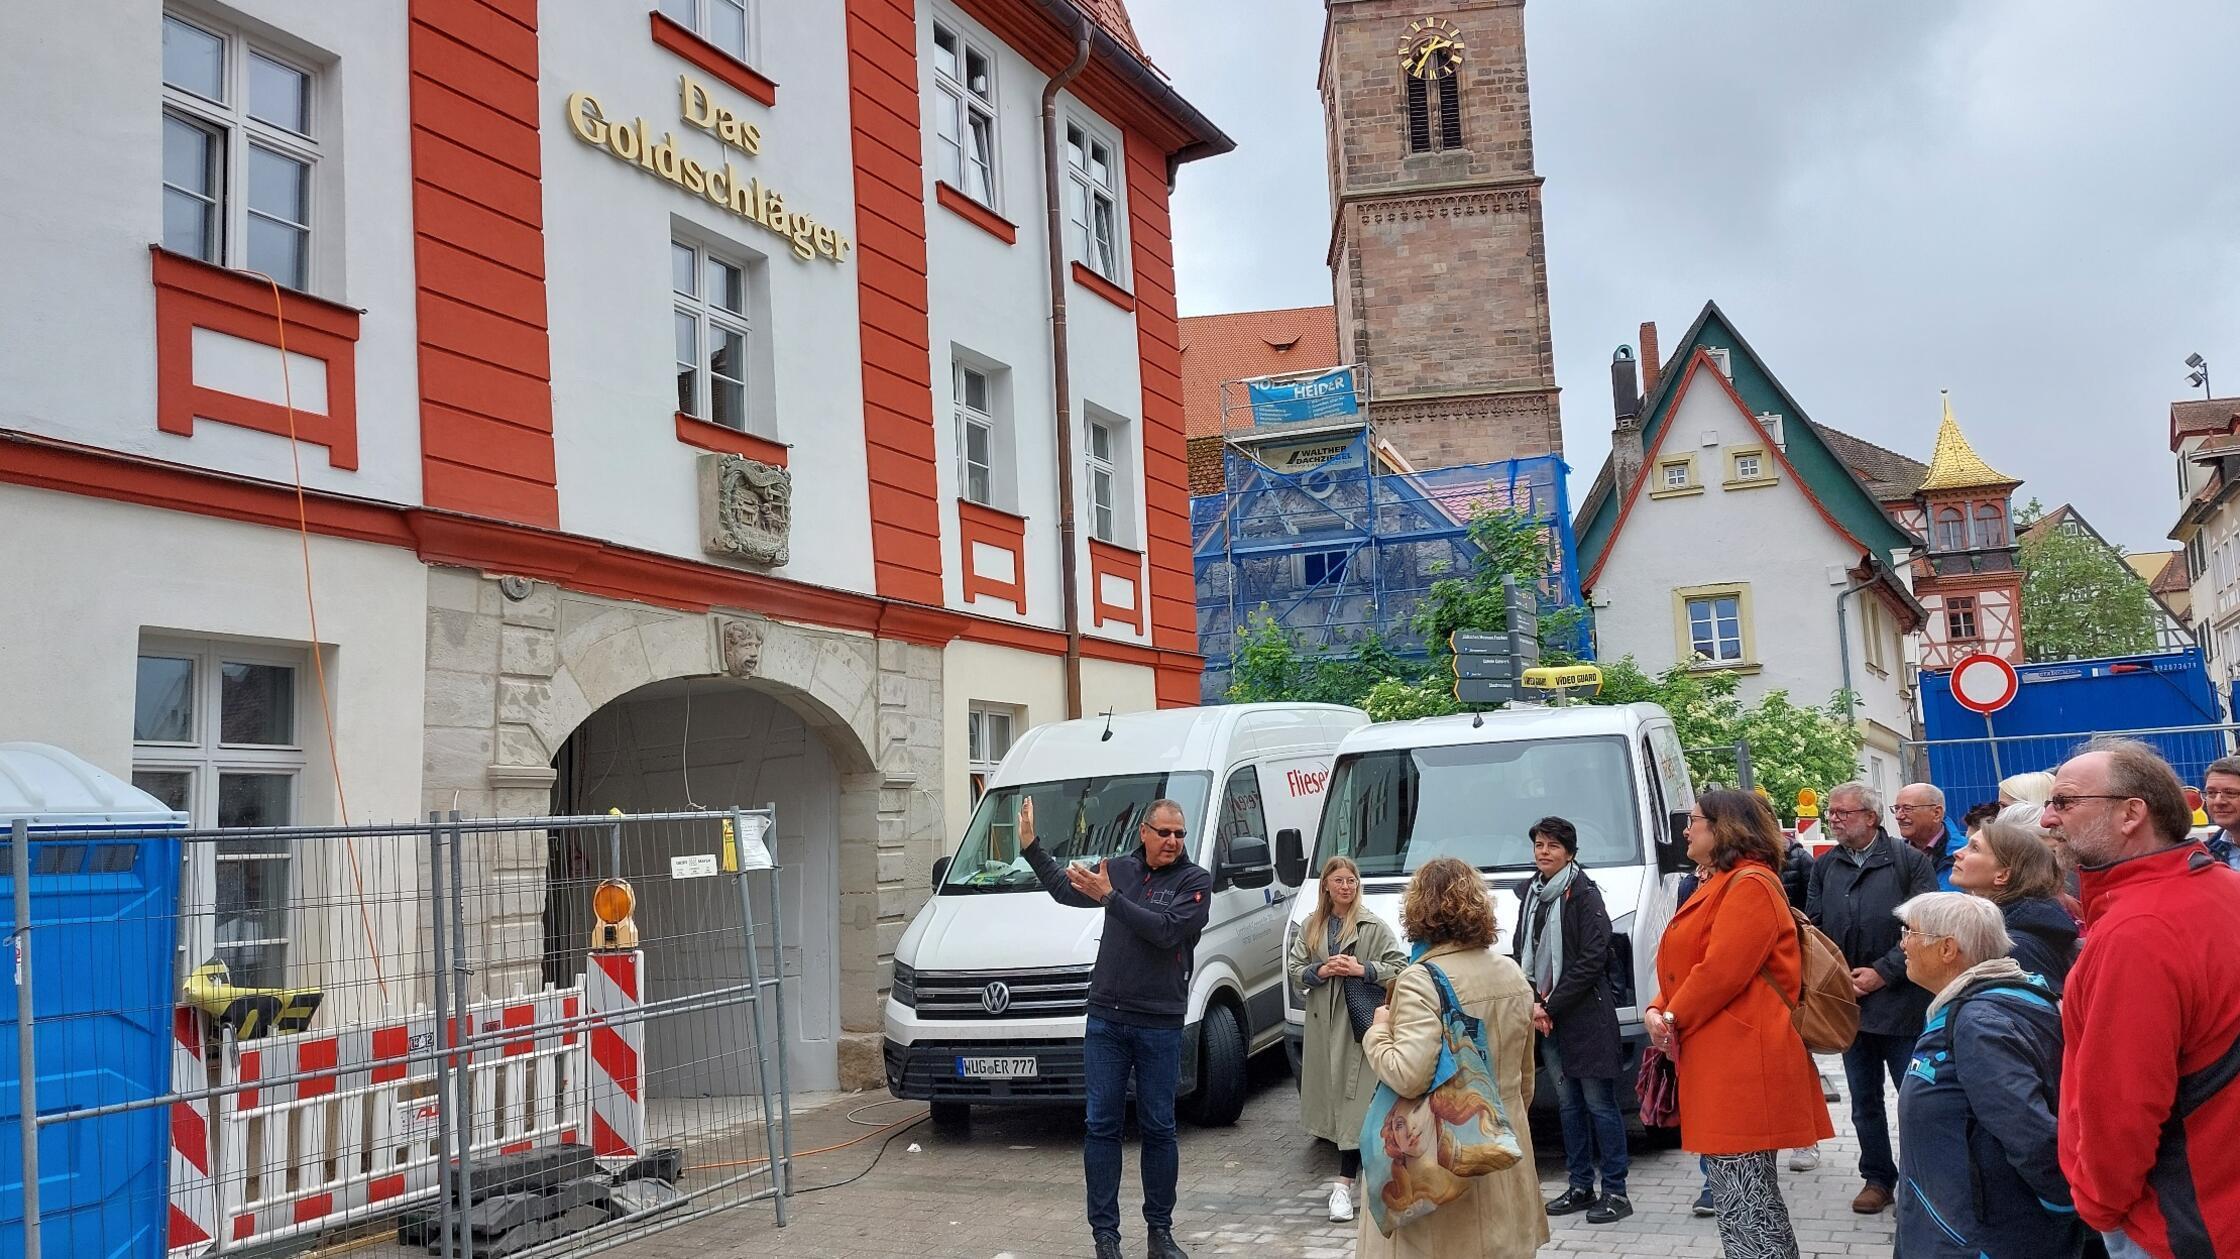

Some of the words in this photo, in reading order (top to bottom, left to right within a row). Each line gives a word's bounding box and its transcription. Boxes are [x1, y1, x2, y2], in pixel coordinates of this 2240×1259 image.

[679, 74, 761, 156] Das
[567, 92, 852, 263] Goldschläger
[1294, 376, 1345, 400] HEIDER
[1301, 445, 1347, 457] WALTHER
[1555, 675, 1576, 686] VIDEO
[1577, 673, 1597, 684] GUARD
[994, 1059, 1010, 1074] ER
[1012, 1059, 1035, 1074] 777
